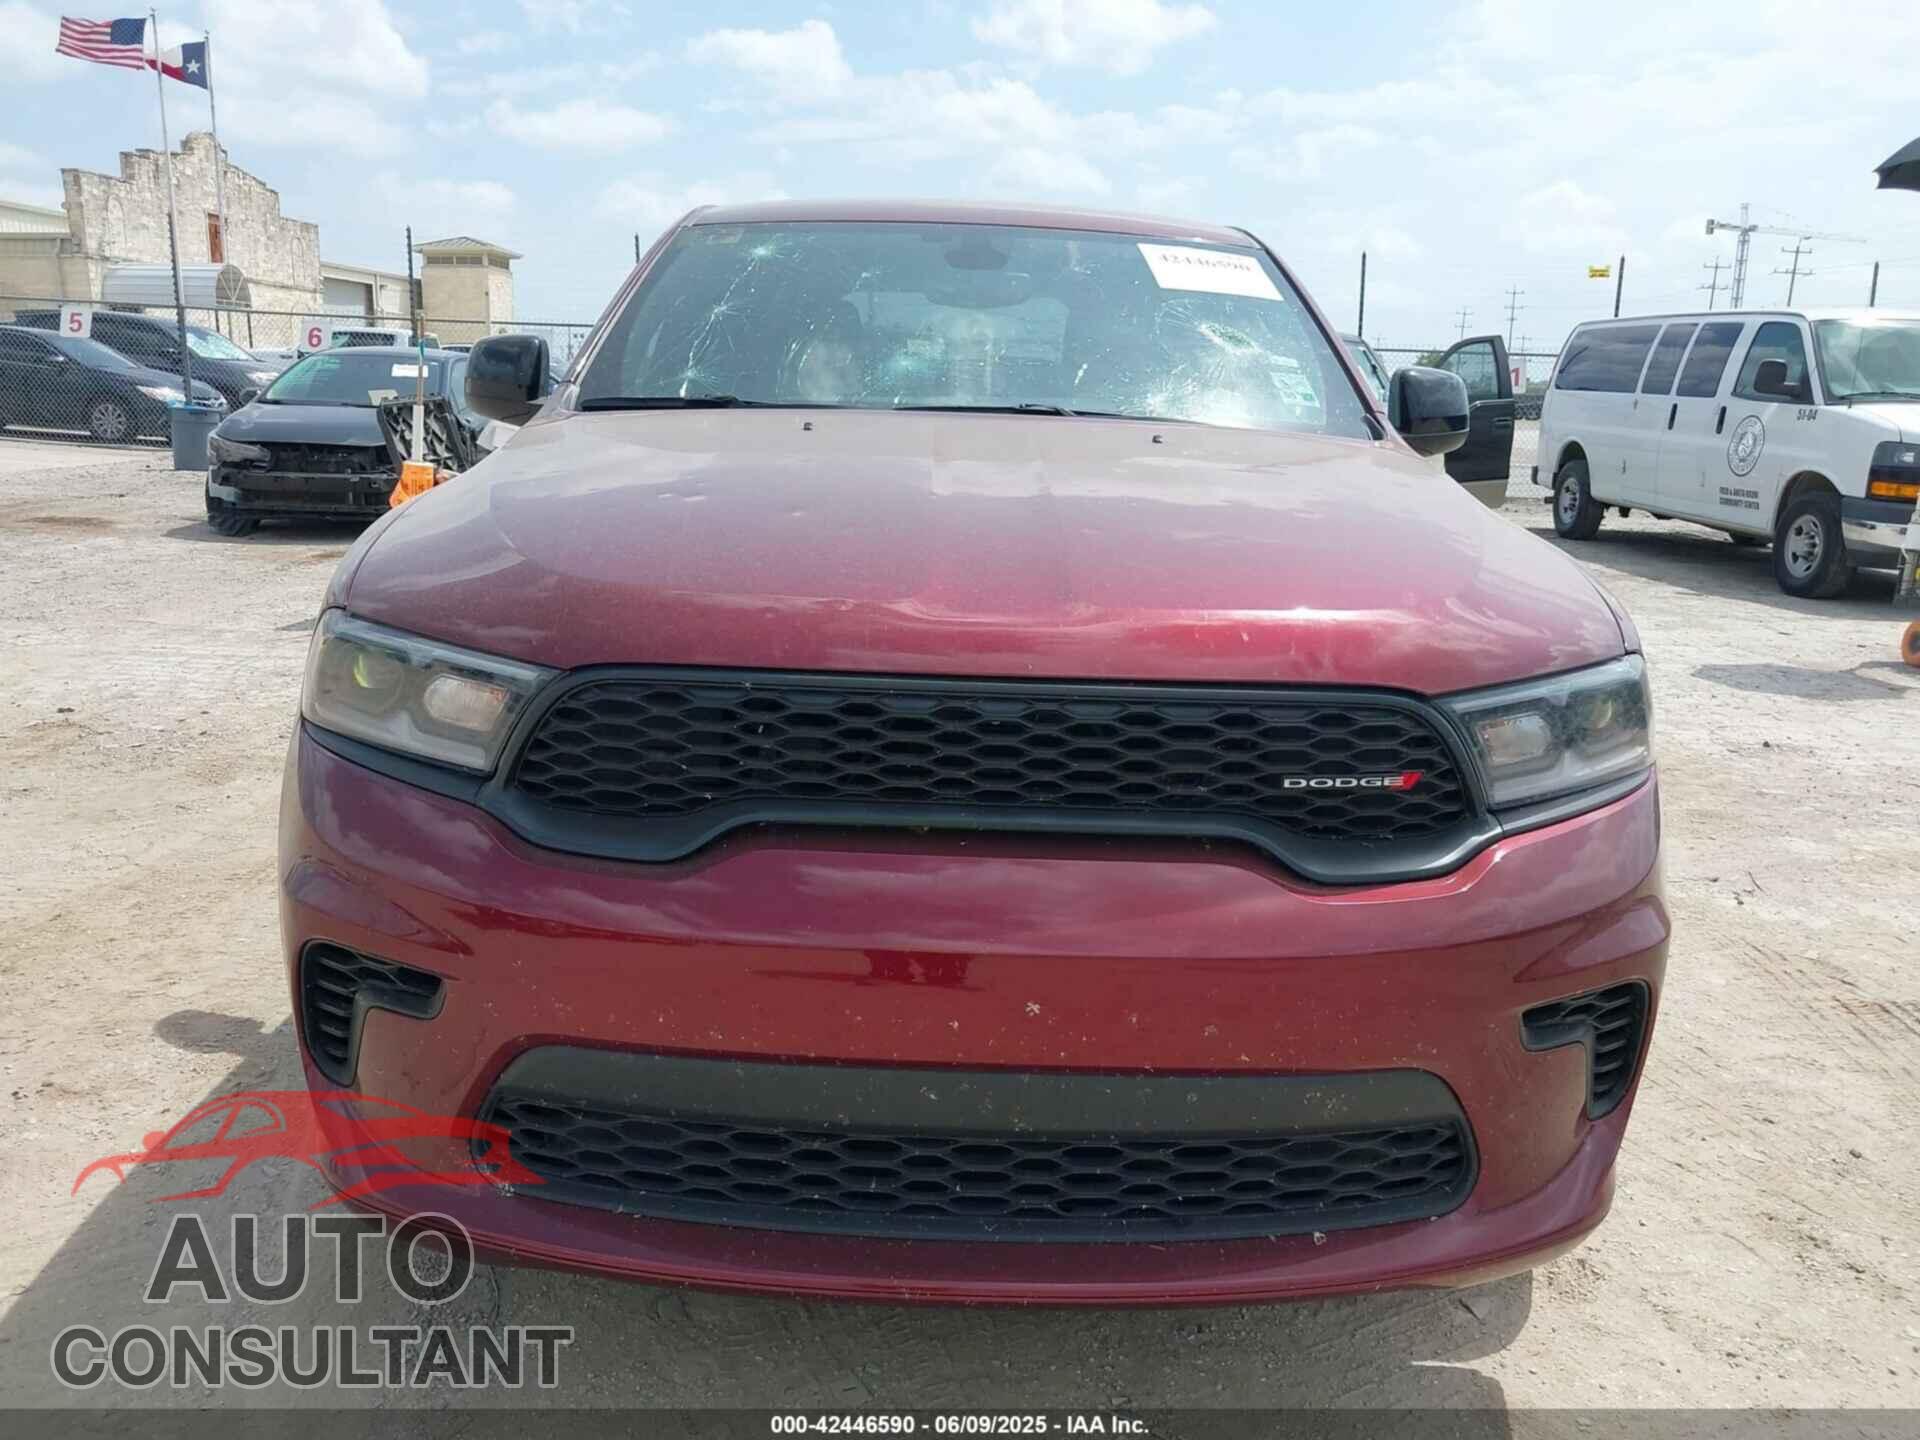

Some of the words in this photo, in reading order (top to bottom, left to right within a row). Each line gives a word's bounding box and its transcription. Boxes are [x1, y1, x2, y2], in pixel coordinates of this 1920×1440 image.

[68, 312, 83, 333] 5
[307, 327, 322, 348] 6
[1510, 367, 1520, 386] 1
[1283, 776, 1405, 788] DODGE
